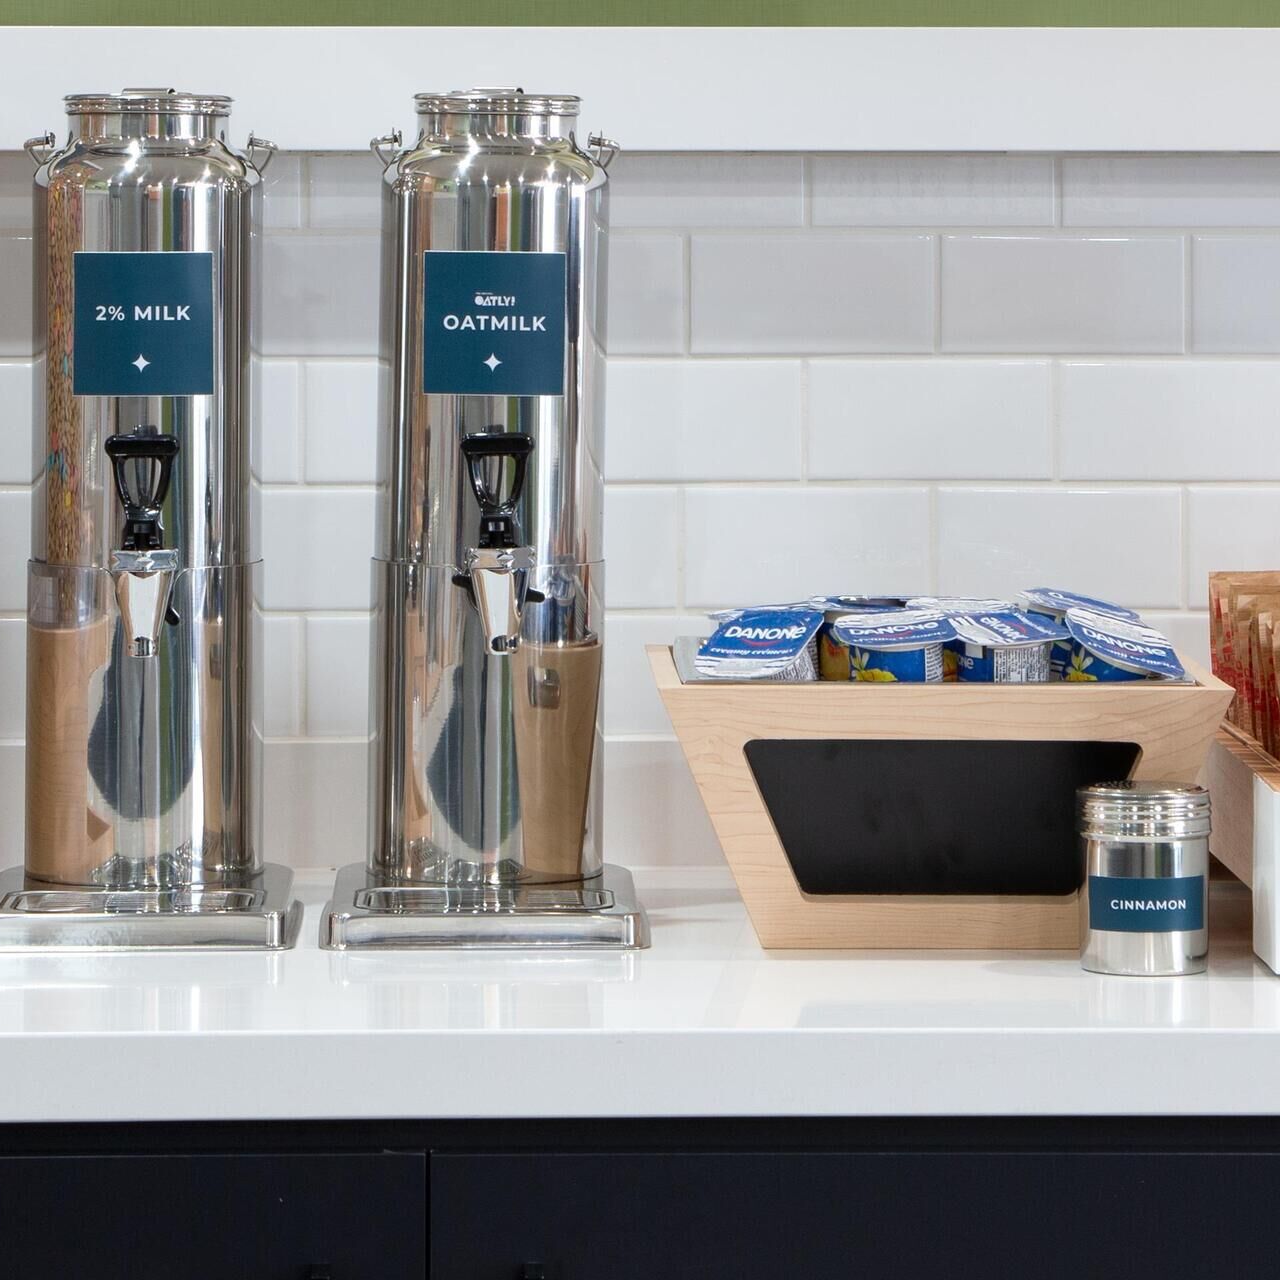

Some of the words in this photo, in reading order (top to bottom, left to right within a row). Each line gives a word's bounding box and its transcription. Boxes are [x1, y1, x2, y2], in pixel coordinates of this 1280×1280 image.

[95, 305, 125, 321] 2%
[134, 305, 191, 322] MILK
[443, 314, 547, 331] OATMILK
[1110, 899, 1187, 911] CINNAMON
